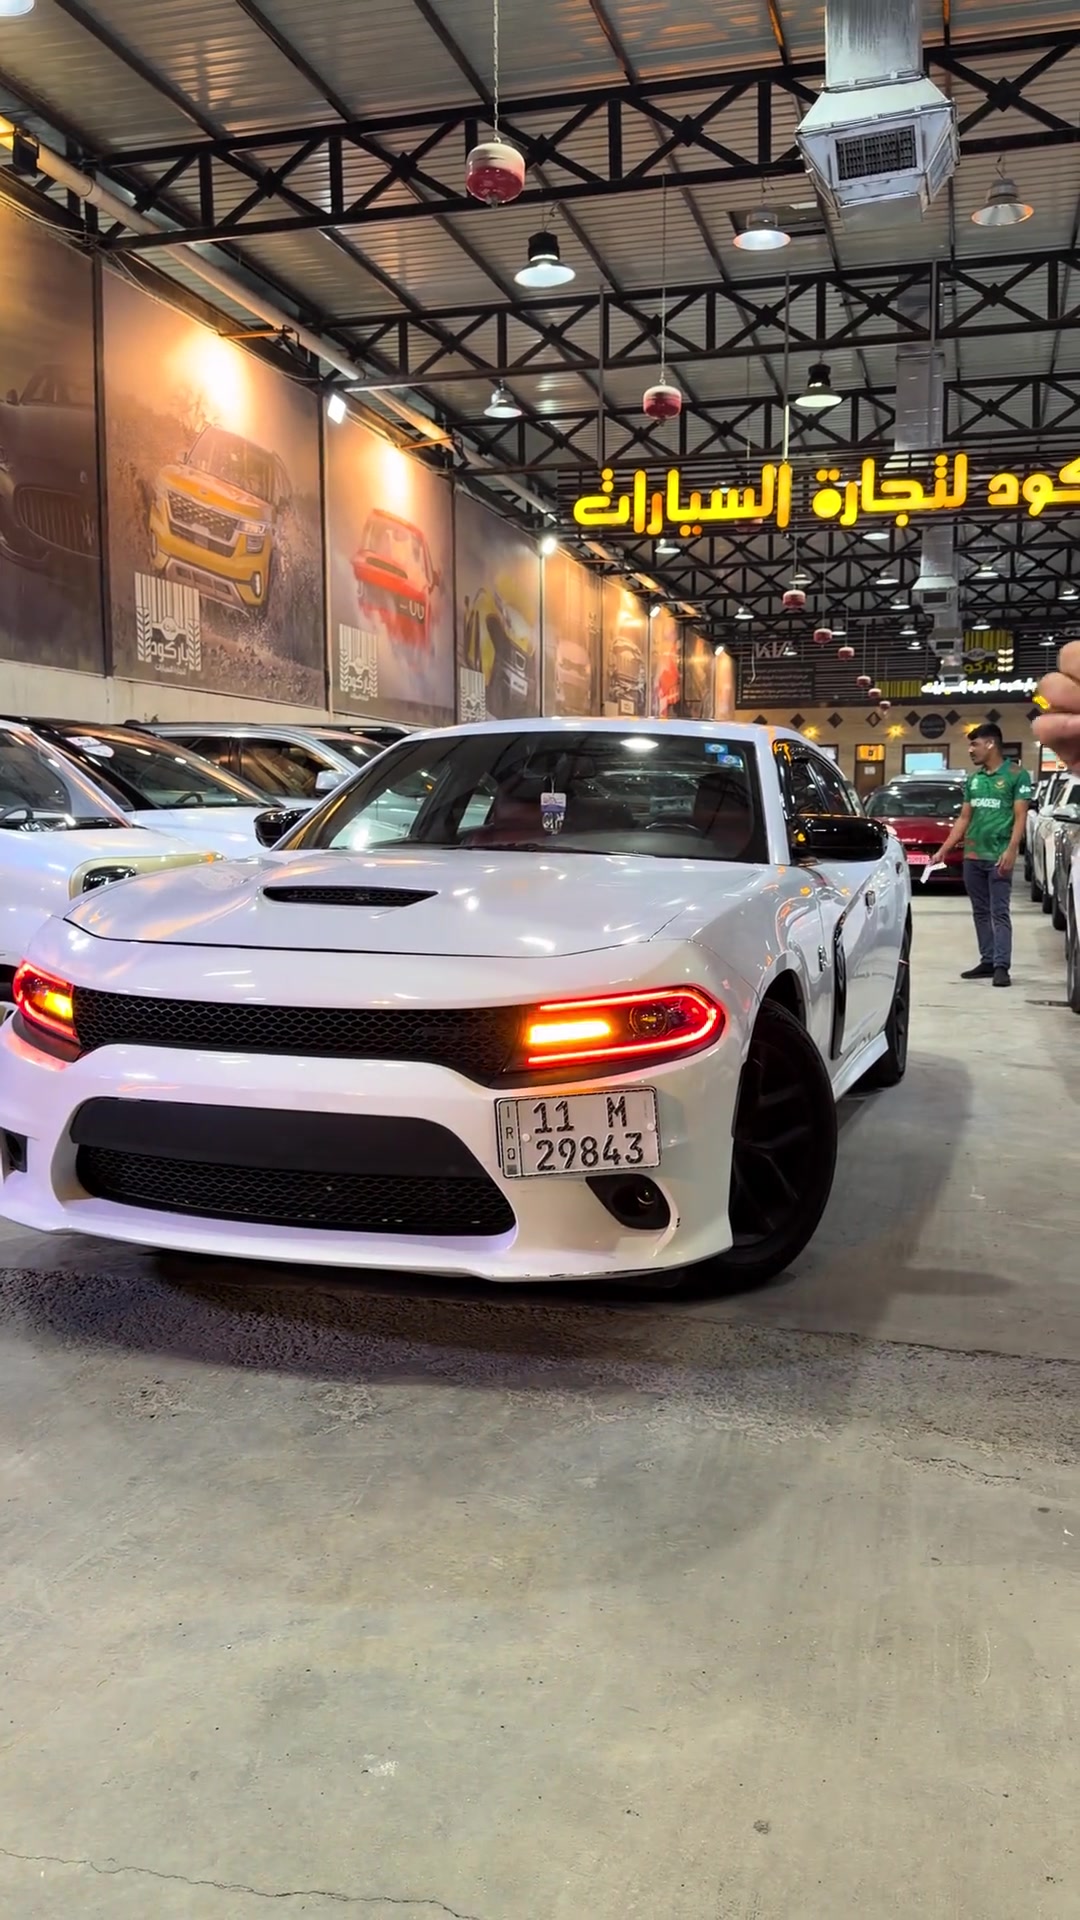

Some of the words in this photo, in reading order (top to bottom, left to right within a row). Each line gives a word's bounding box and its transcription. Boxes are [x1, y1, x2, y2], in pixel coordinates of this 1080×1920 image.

[573, 463, 792, 537] السيارات
[812, 452, 968, 527] لتجارة
[151, 641, 189, 666] باركود
[963, 661, 998, 674] باركو
[533, 1100, 575, 1134] 11
[606, 1096, 627, 1128] M
[535, 1131, 644, 1171] 29843
